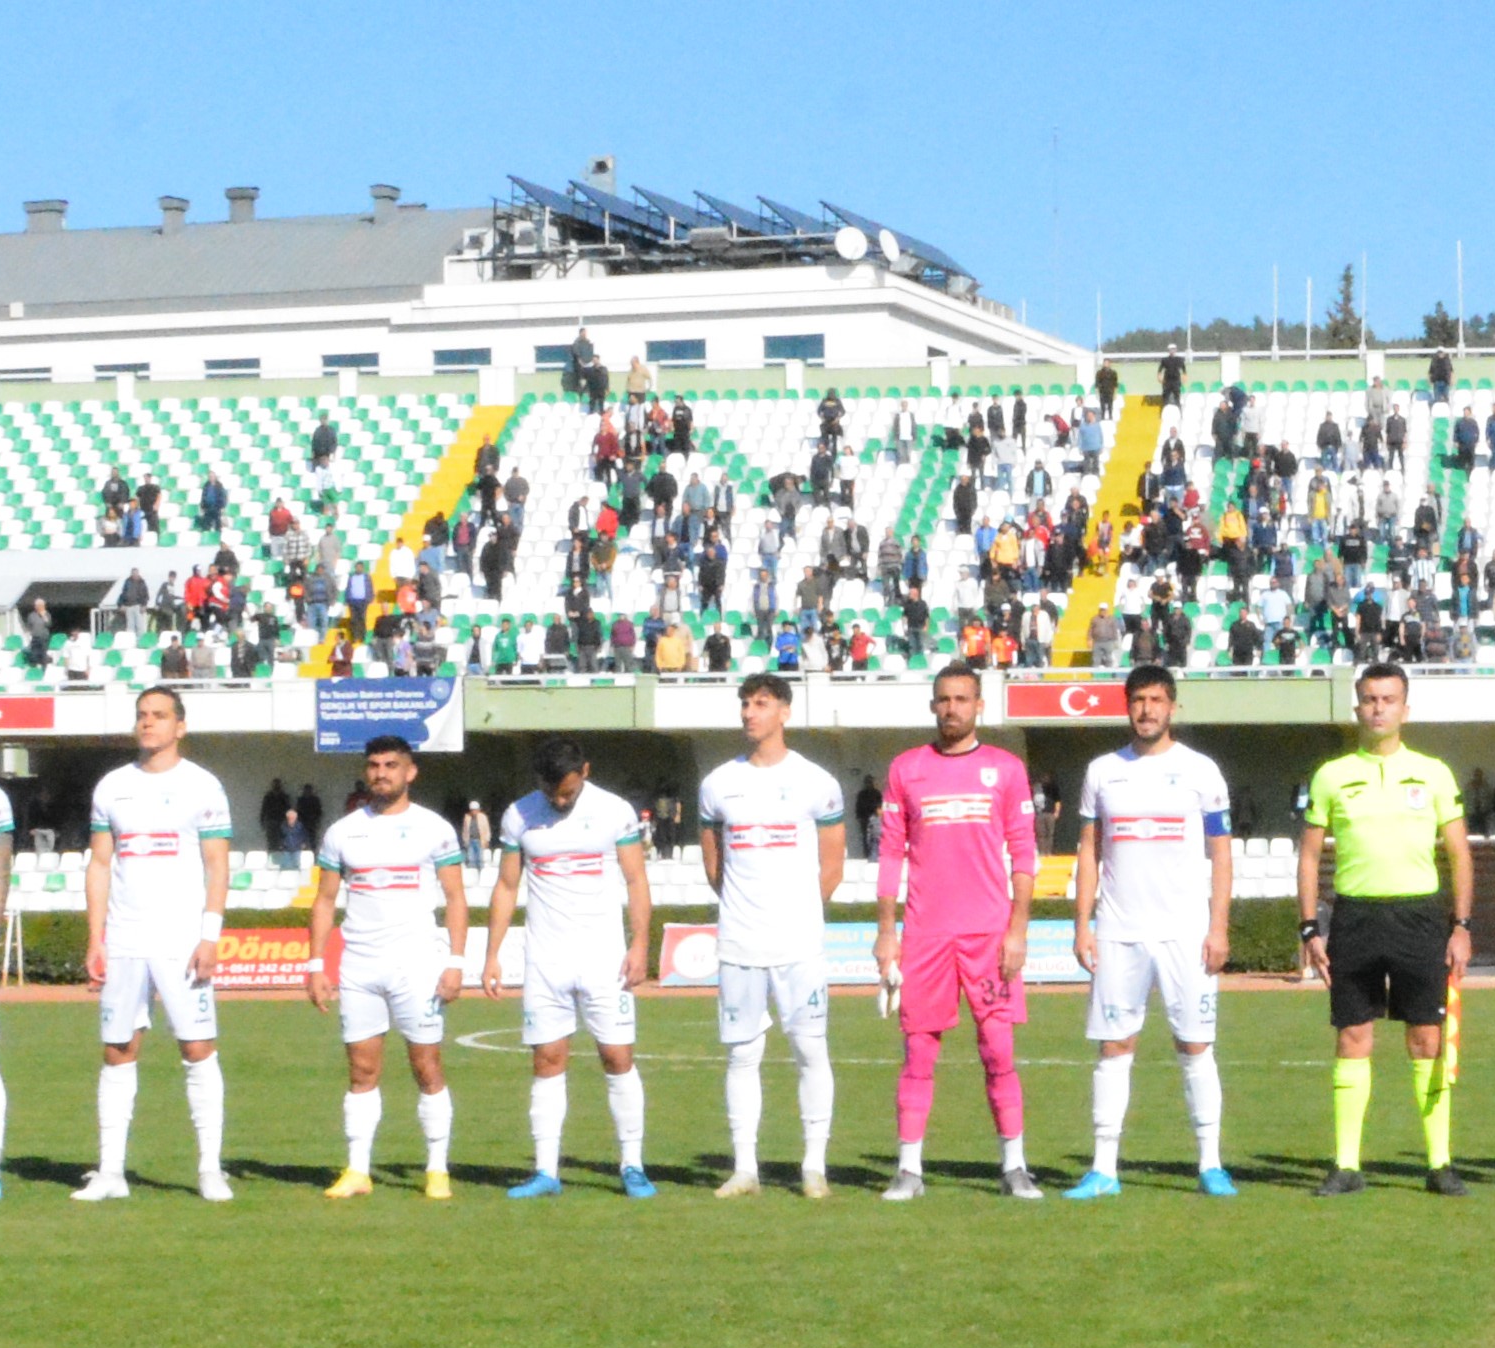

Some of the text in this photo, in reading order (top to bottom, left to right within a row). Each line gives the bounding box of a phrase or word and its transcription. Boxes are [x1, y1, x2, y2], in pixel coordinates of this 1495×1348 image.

[197, 993, 209, 1013] 5
[981, 979, 1011, 1006] 34
[618, 994, 631, 1015] 8
